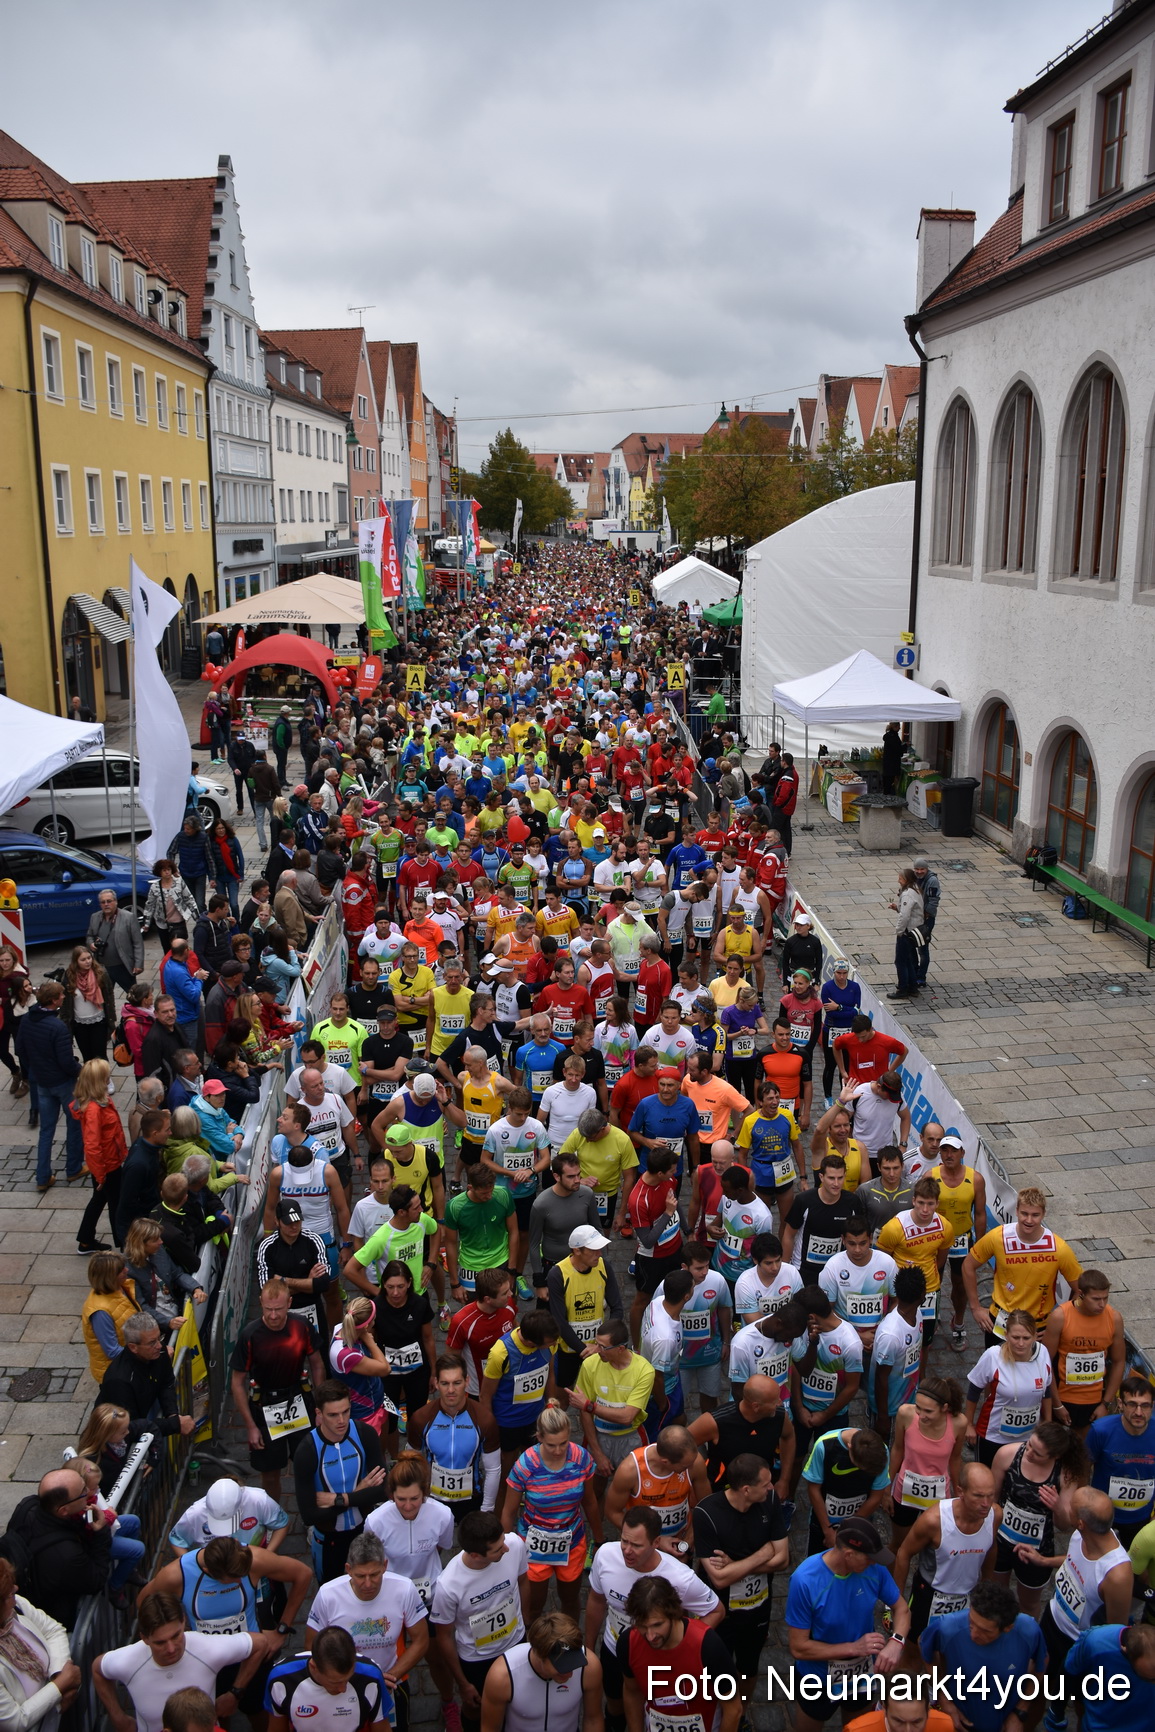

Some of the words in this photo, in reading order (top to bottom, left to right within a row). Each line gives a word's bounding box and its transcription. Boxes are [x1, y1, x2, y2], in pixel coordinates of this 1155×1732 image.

[632, 594, 638, 602] B
[410, 673, 420, 686] A
[671, 671, 682, 684] A
[442, 1019, 463, 1028] 2137
[555, 1023, 574, 1033] 2676
[790, 1029, 809, 1040] 2812
[737, 1040, 751, 1051] 362
[328, 1054, 350, 1064] 2502
[375, 1083, 397, 1093] 2533
[467, 1117, 488, 1129] 3011
[507, 1157, 533, 1169] 2648
[781, 1162, 792, 1175] 59
[811, 1242, 839, 1254] 2284
[906, 1240, 924, 1248] MAX
[926, 1235, 945, 1243] BÖGL
[398, 1245, 417, 1257] RUN
[1005, 1256, 1029, 1265] MAX
[1031, 1254, 1058, 1263] BÖGL
[851, 1301, 882, 1315] 3084
[577, 1327, 597, 1341] 501
[1074, 1340, 1098, 1348] OEXL
[389, 1351, 419, 1366] 2142
[762, 1360, 787, 1377] 3085
[1074, 1360, 1099, 1373] 366
[522, 1375, 545, 1393] 539
[273, 1405, 300, 1425] 342
[1004, 1413, 1038, 1427] 3035
[439, 1475, 464, 1491] 131
[439, 1490, 462, 1498] Andreas
[911, 1483, 938, 1498] 531
[1118, 1486, 1147, 1500] 206
[828, 1501, 862, 1517] 3095
[662, 1510, 688, 1526] 435
[1004, 1510, 1040, 1538] 3096
[530, 1536, 568, 1553] 3016
[745, 1579, 761, 1598] 32
[1056, 1572, 1081, 1611] 2657
[470, 1616, 487, 1626] PARTL
[487, 1604, 508, 1618] Neumarkt
[213, 1620, 239, 1628] Neumarkt
[486, 1612, 507, 1632] 79
[490, 1629, 509, 1641] Frank
[298, 1705, 313, 1714] tkn
[650, 1712, 667, 1722] PARTL
[667, 1717, 693, 1725] Neumarkt
